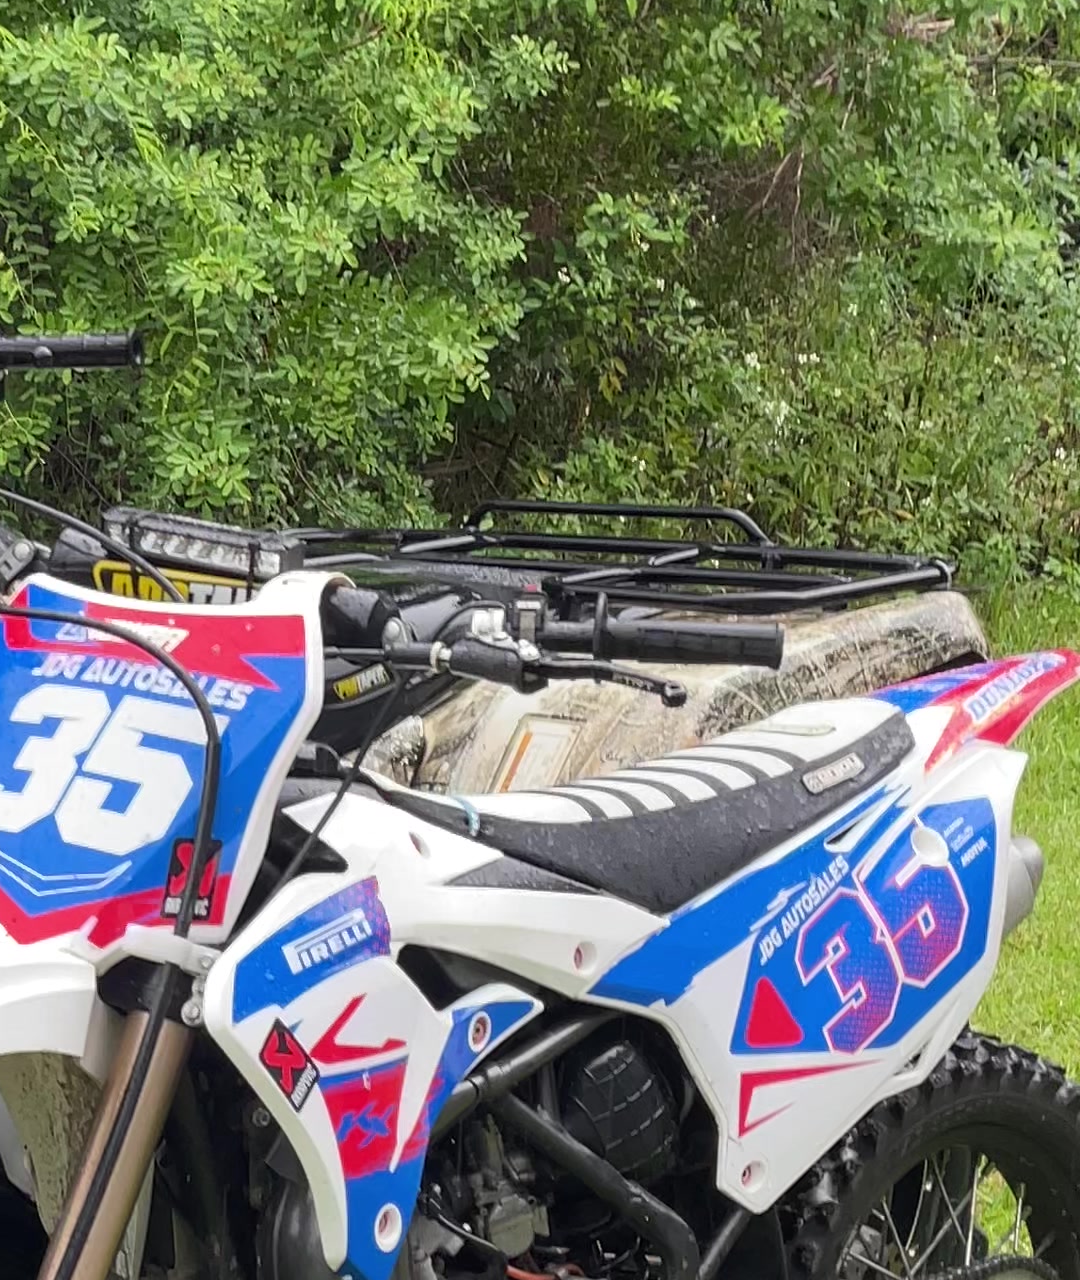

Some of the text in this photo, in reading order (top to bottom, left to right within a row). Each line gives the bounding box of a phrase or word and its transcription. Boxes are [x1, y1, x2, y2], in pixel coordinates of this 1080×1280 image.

[32, 651, 86, 678] JDG
[280, 907, 373, 975] PIRELLI
[758, 854, 850, 967] JDG AUTOSALES
[795, 814, 969, 1055] 35
